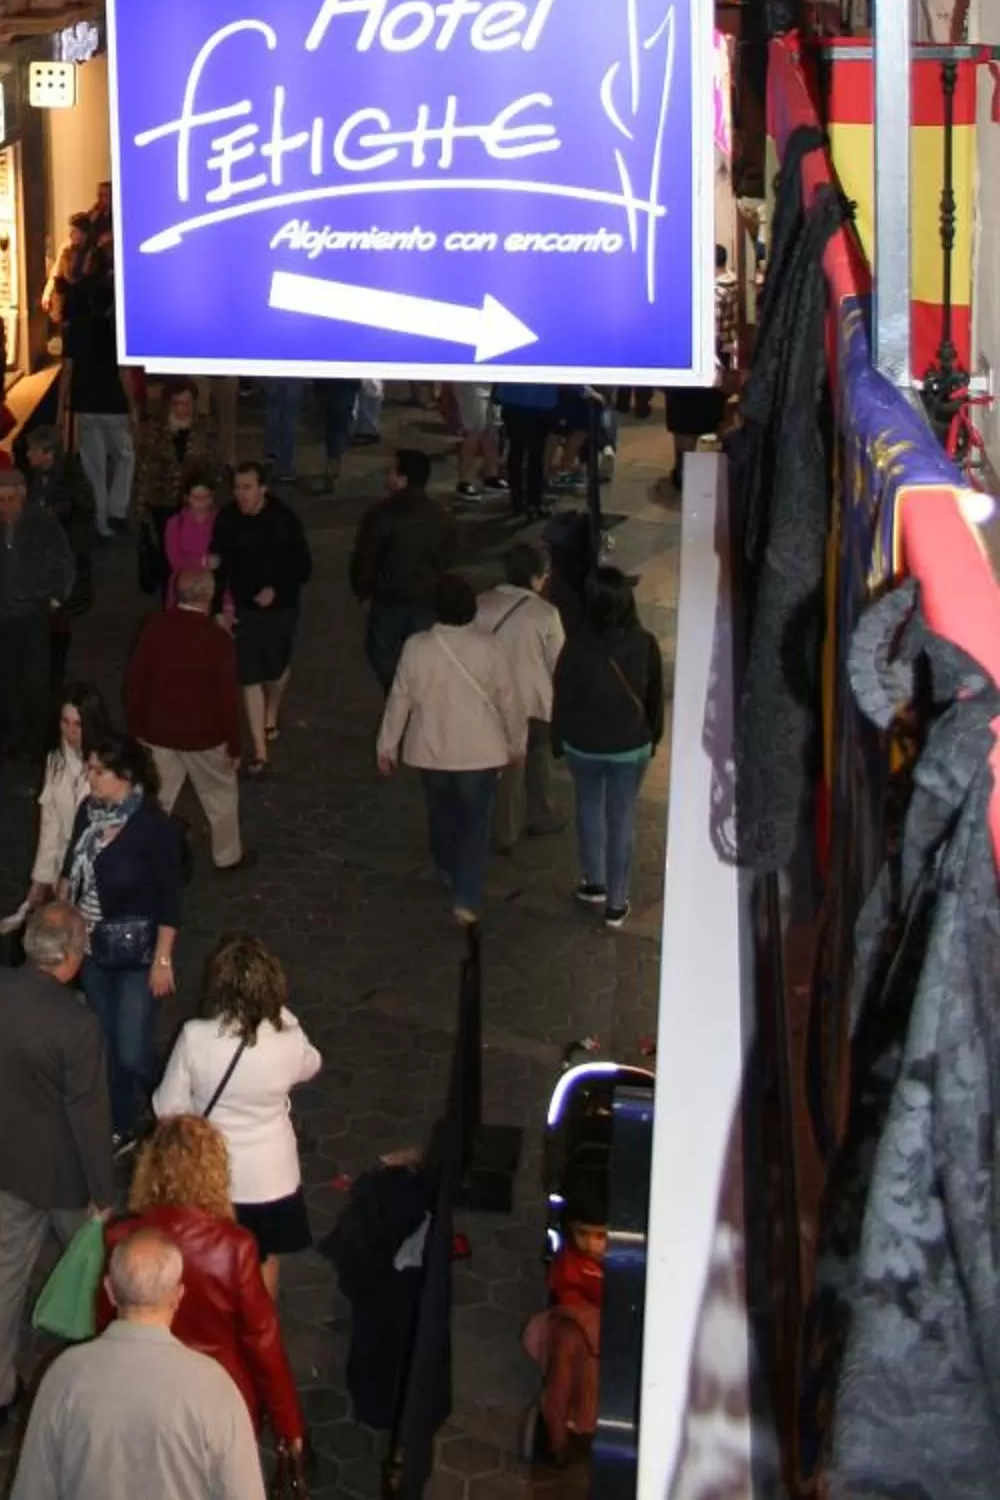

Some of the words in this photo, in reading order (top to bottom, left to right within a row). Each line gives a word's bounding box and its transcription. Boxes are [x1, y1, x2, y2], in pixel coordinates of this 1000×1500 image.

[270, 218, 437, 259] Alojamiento
[443, 230, 498, 252] con
[503, 225, 624, 254] encanto
